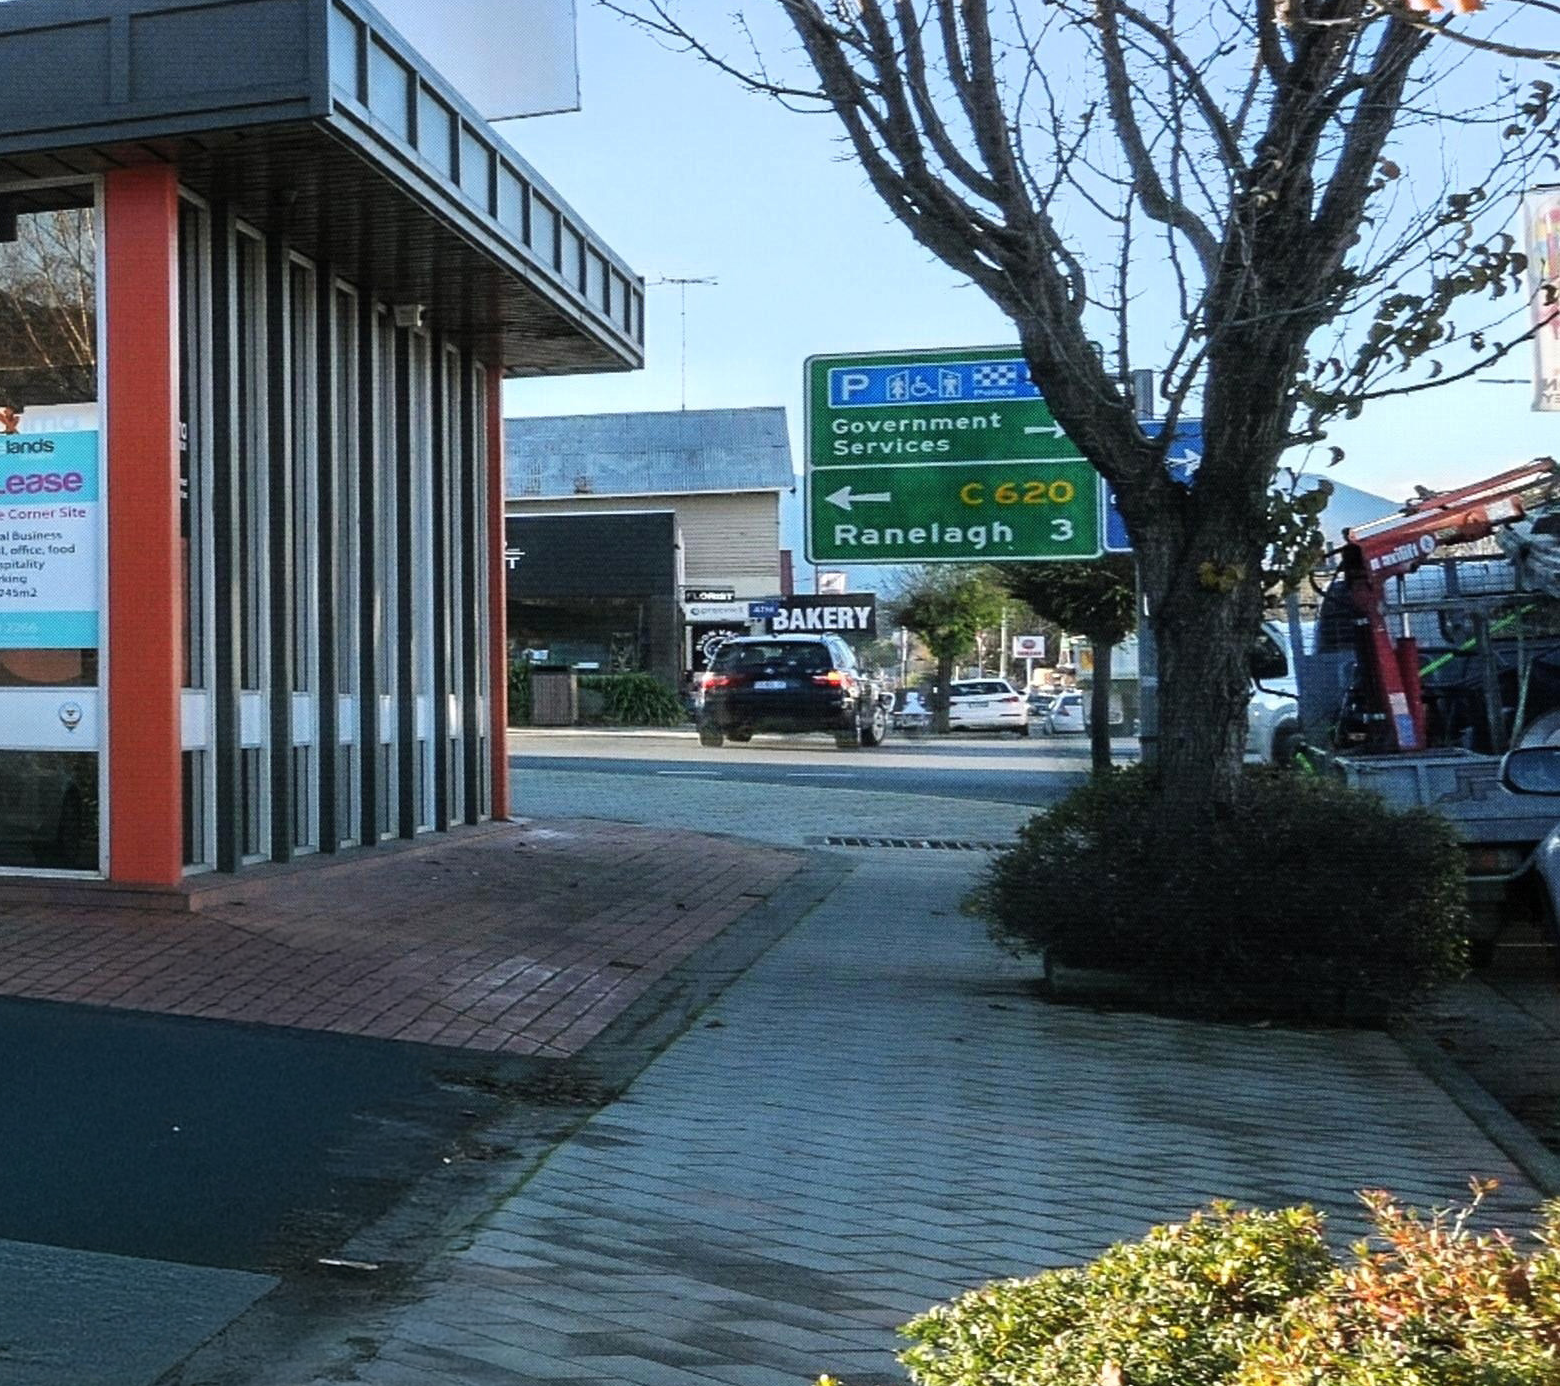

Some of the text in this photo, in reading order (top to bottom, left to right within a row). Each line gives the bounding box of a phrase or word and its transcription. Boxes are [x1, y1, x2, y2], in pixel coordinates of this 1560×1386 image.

[841, 374, 870, 401] P
[832, 413, 1002, 434] Government
[833, 438, 950, 455] Services
[959, 480, 1076, 505] C 620
[8, 508, 55, 520] Corner
[59, 506, 87, 519] Site
[12, 530, 63, 541] Business
[833, 518, 1074, 549] Ranelagh 3
[10, 545, 45, 556] office,
[47, 543, 76, 554] food
[686, 591, 733, 601] FLORIST
[773, 606, 872, 630] BAKERY
